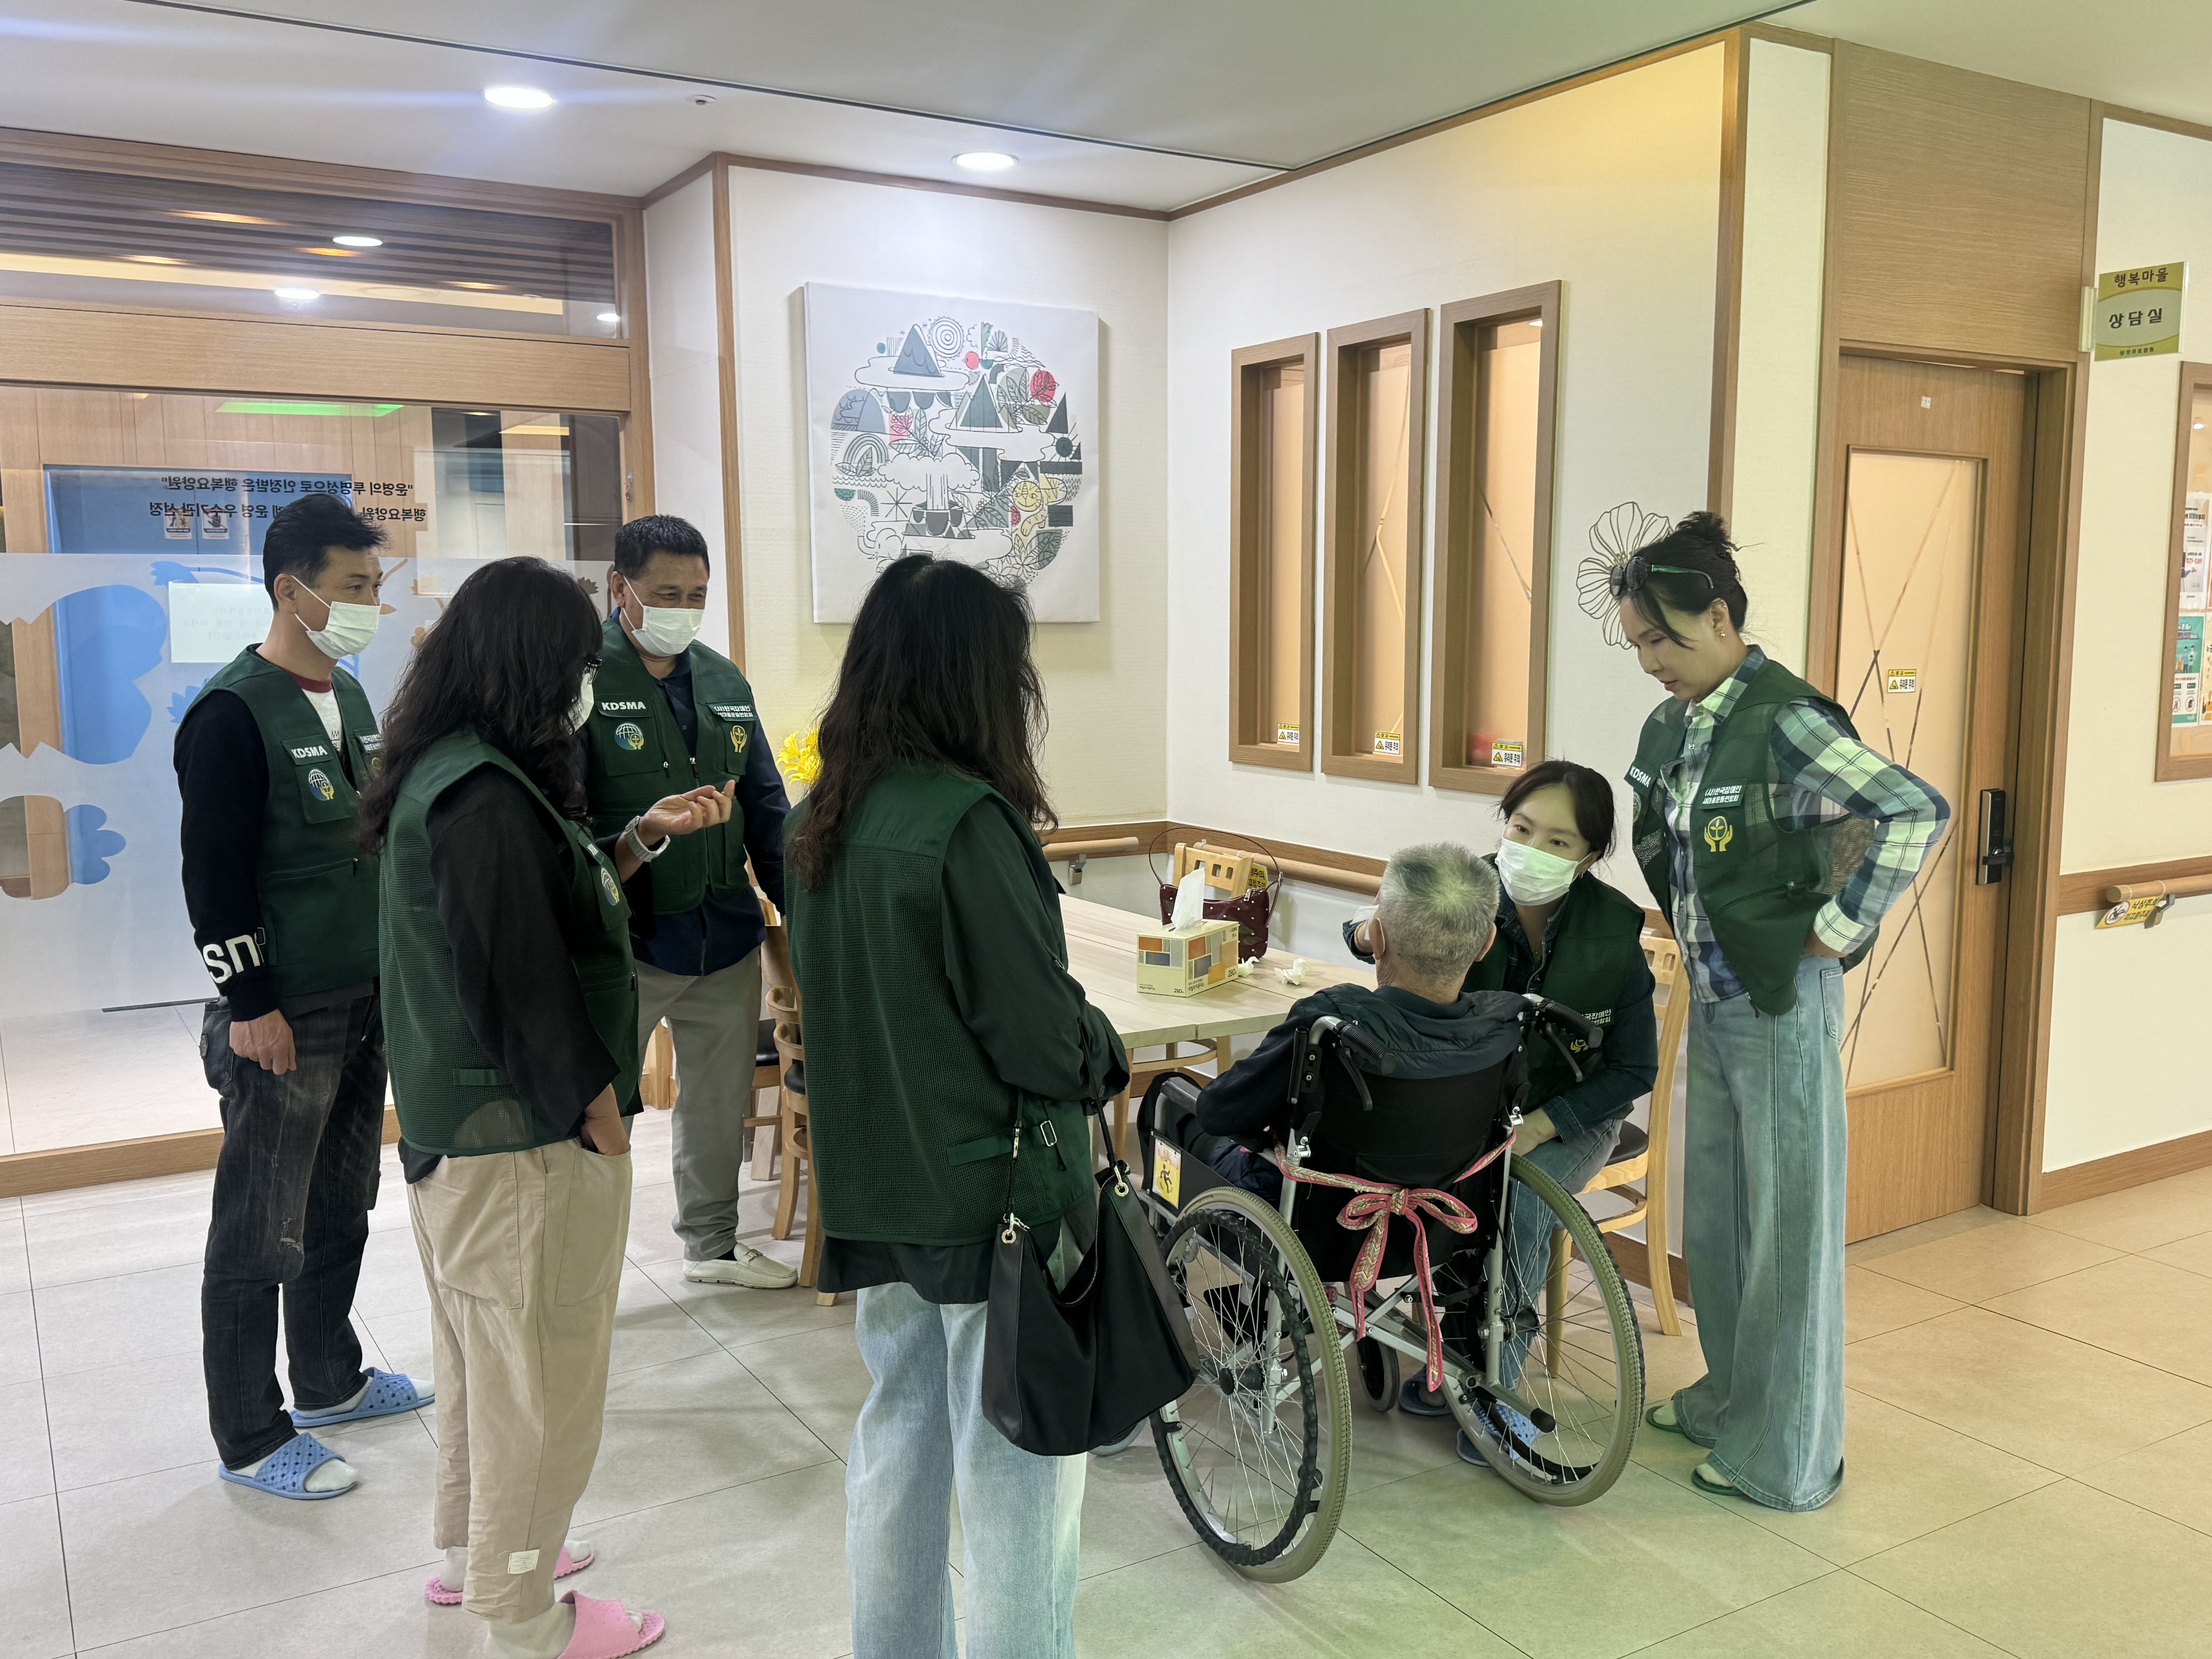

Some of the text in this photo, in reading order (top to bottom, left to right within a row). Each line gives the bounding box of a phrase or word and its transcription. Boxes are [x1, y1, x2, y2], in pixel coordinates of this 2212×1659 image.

[2114, 267, 2169, 288] 행복마을
[2108, 307, 2163, 329] 상담실
[601, 701, 647, 711] KDSMA
[291, 745, 328, 759] KDSMA
[1629, 765, 1652, 788] KDSMA
[203, 932, 264, 984] sn
